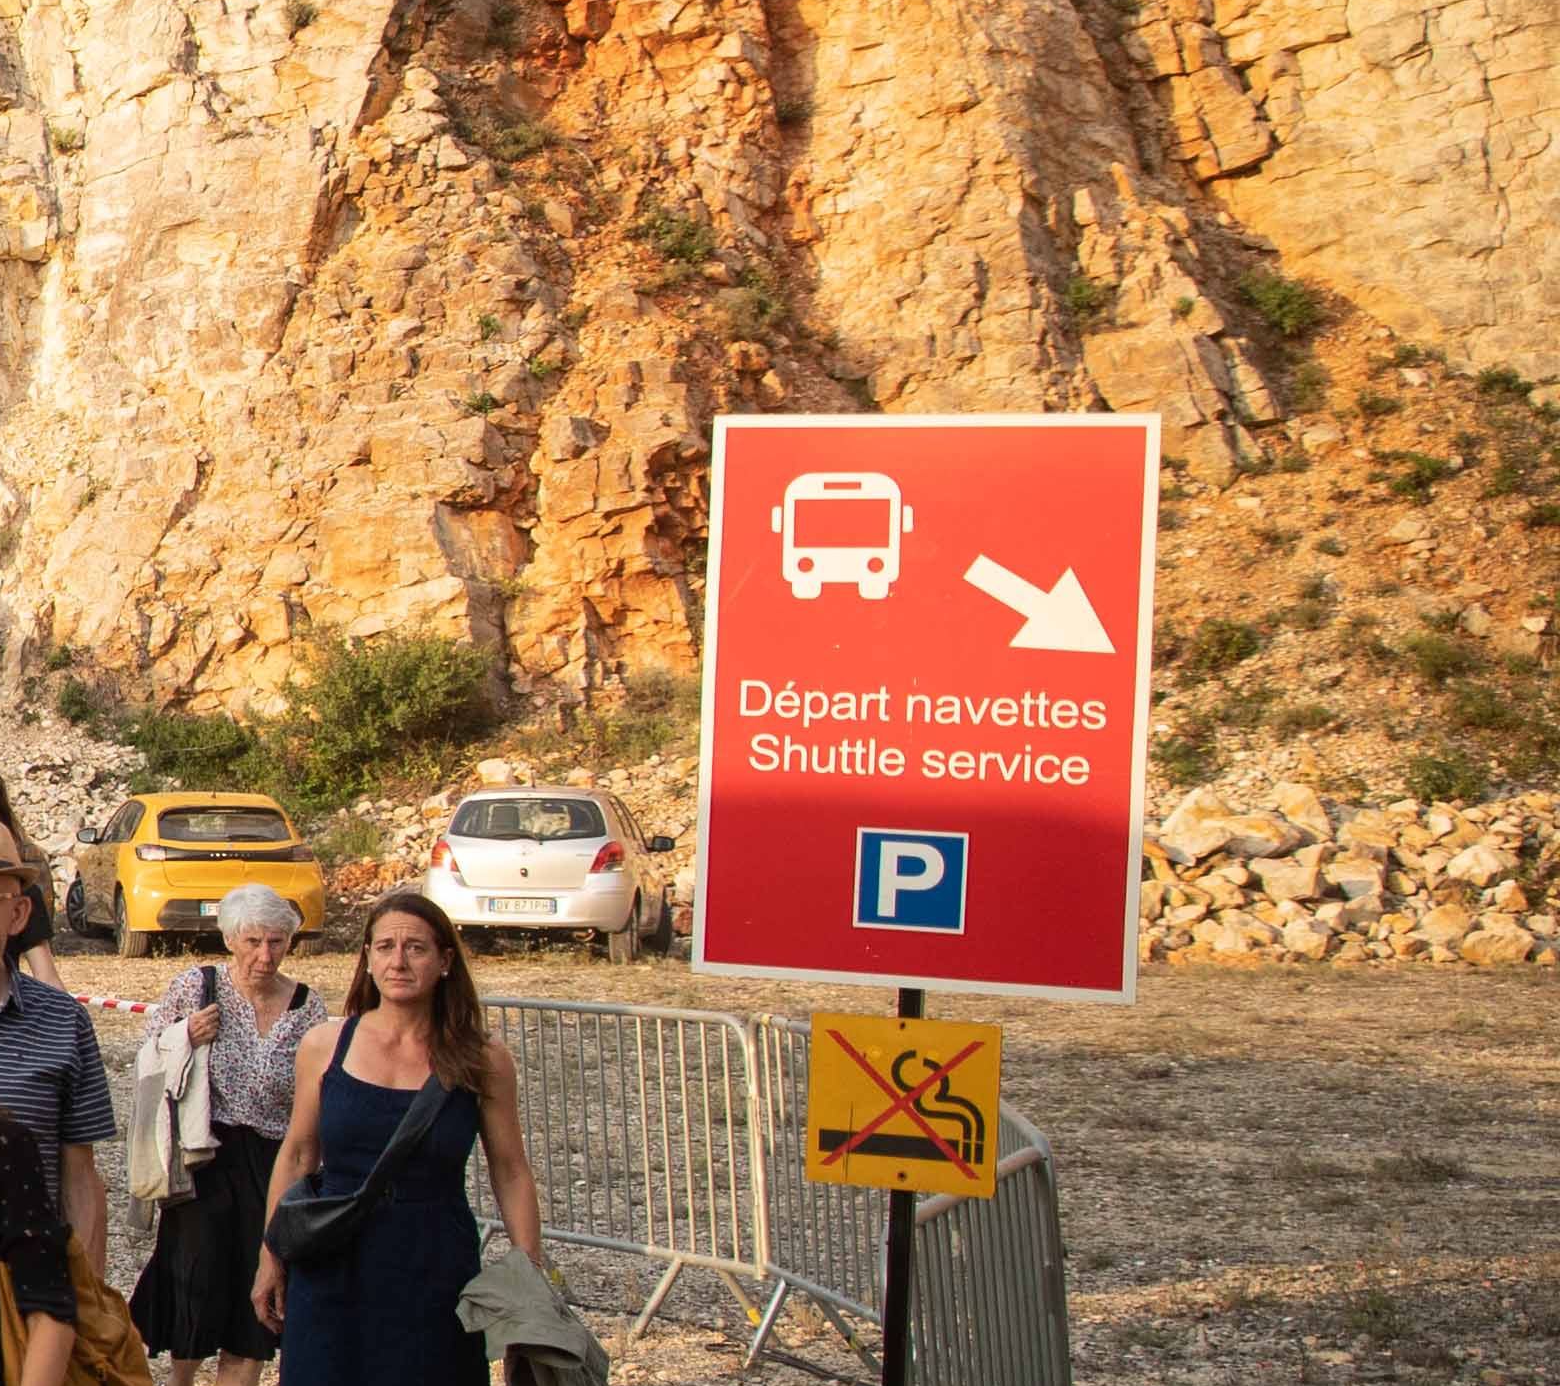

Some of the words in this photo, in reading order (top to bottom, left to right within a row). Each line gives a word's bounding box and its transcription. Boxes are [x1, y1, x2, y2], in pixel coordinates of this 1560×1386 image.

[739, 679, 890, 727] Départ
[906, 691, 1107, 730] navettes
[749, 733, 906, 776] Shuttle
[922, 745, 1090, 785] service
[877, 840, 945, 918] P
